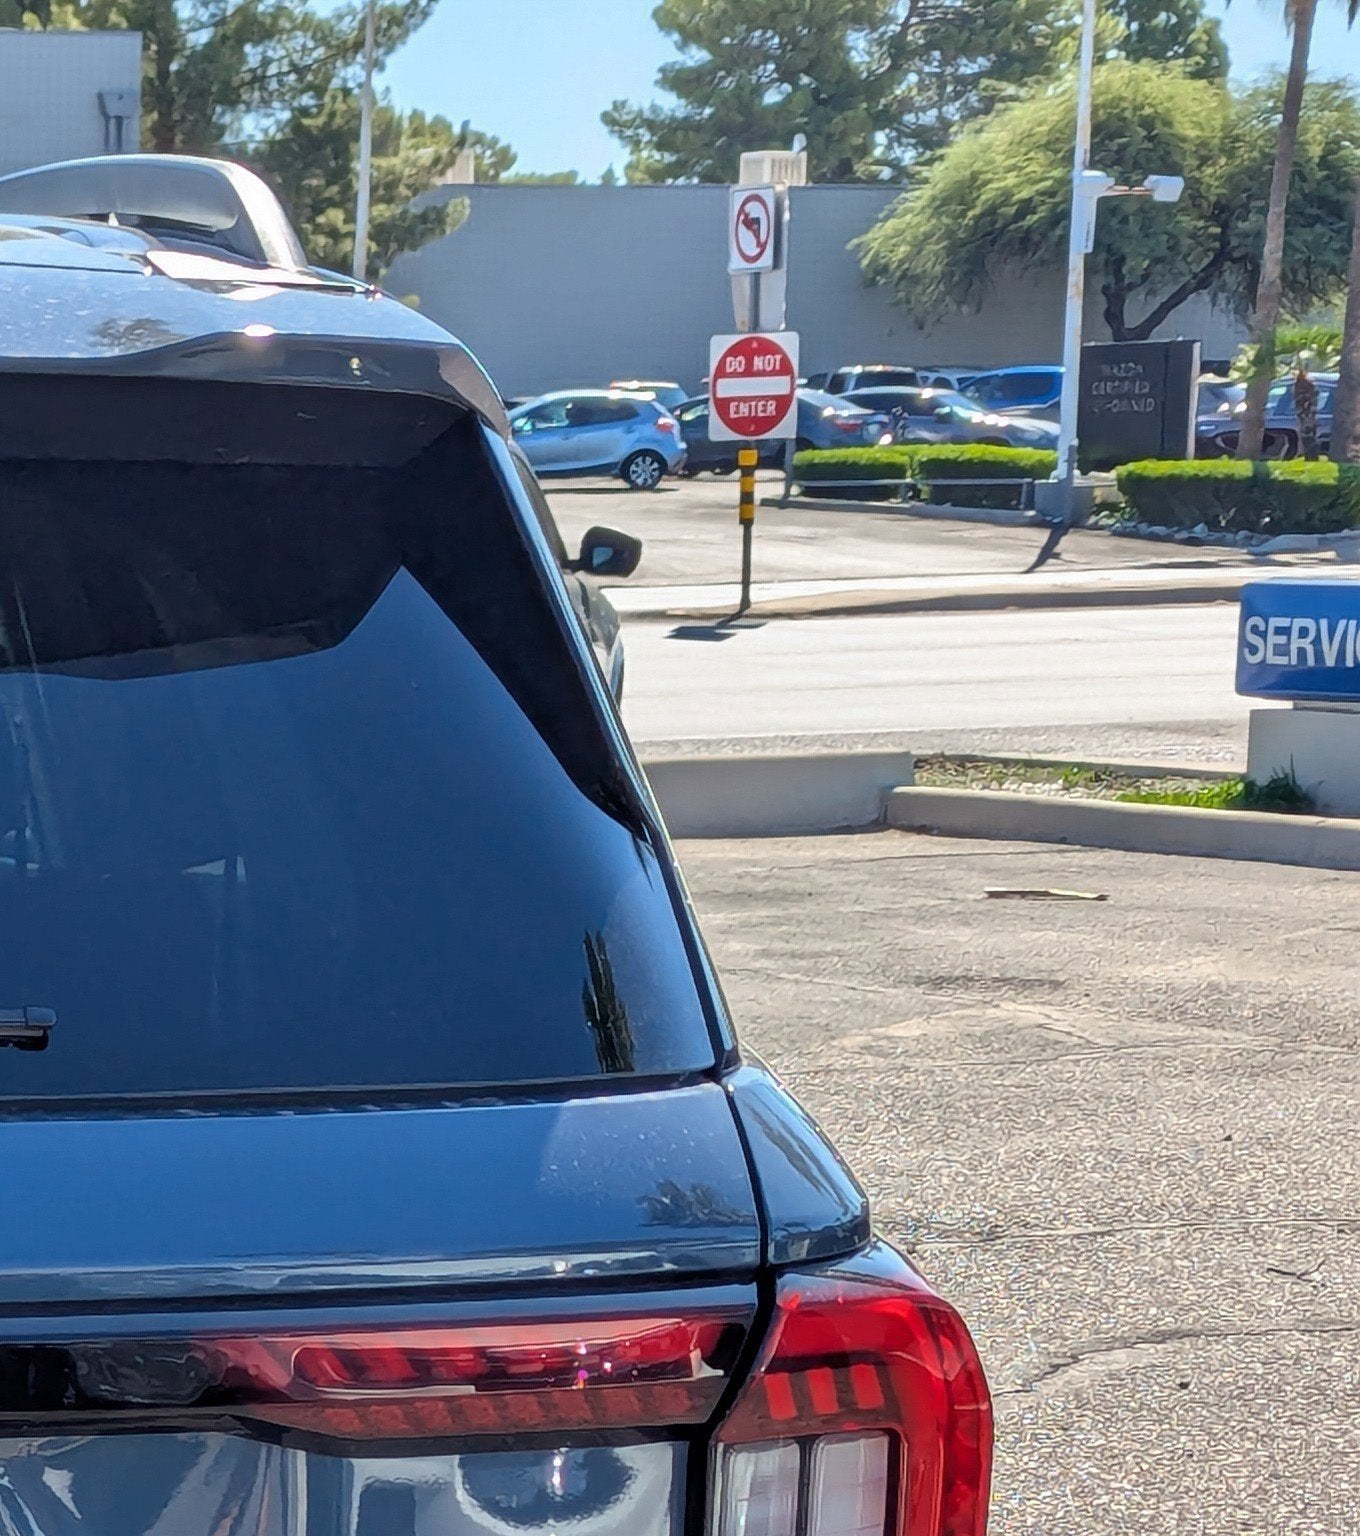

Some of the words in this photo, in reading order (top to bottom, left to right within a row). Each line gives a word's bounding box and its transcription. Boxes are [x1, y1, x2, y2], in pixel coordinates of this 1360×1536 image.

[725, 355, 746, 373] DO
[753, 354, 783, 371] NOT
[729, 400, 777, 419] ENTER
[1243, 615, 1360, 668] SERVI
